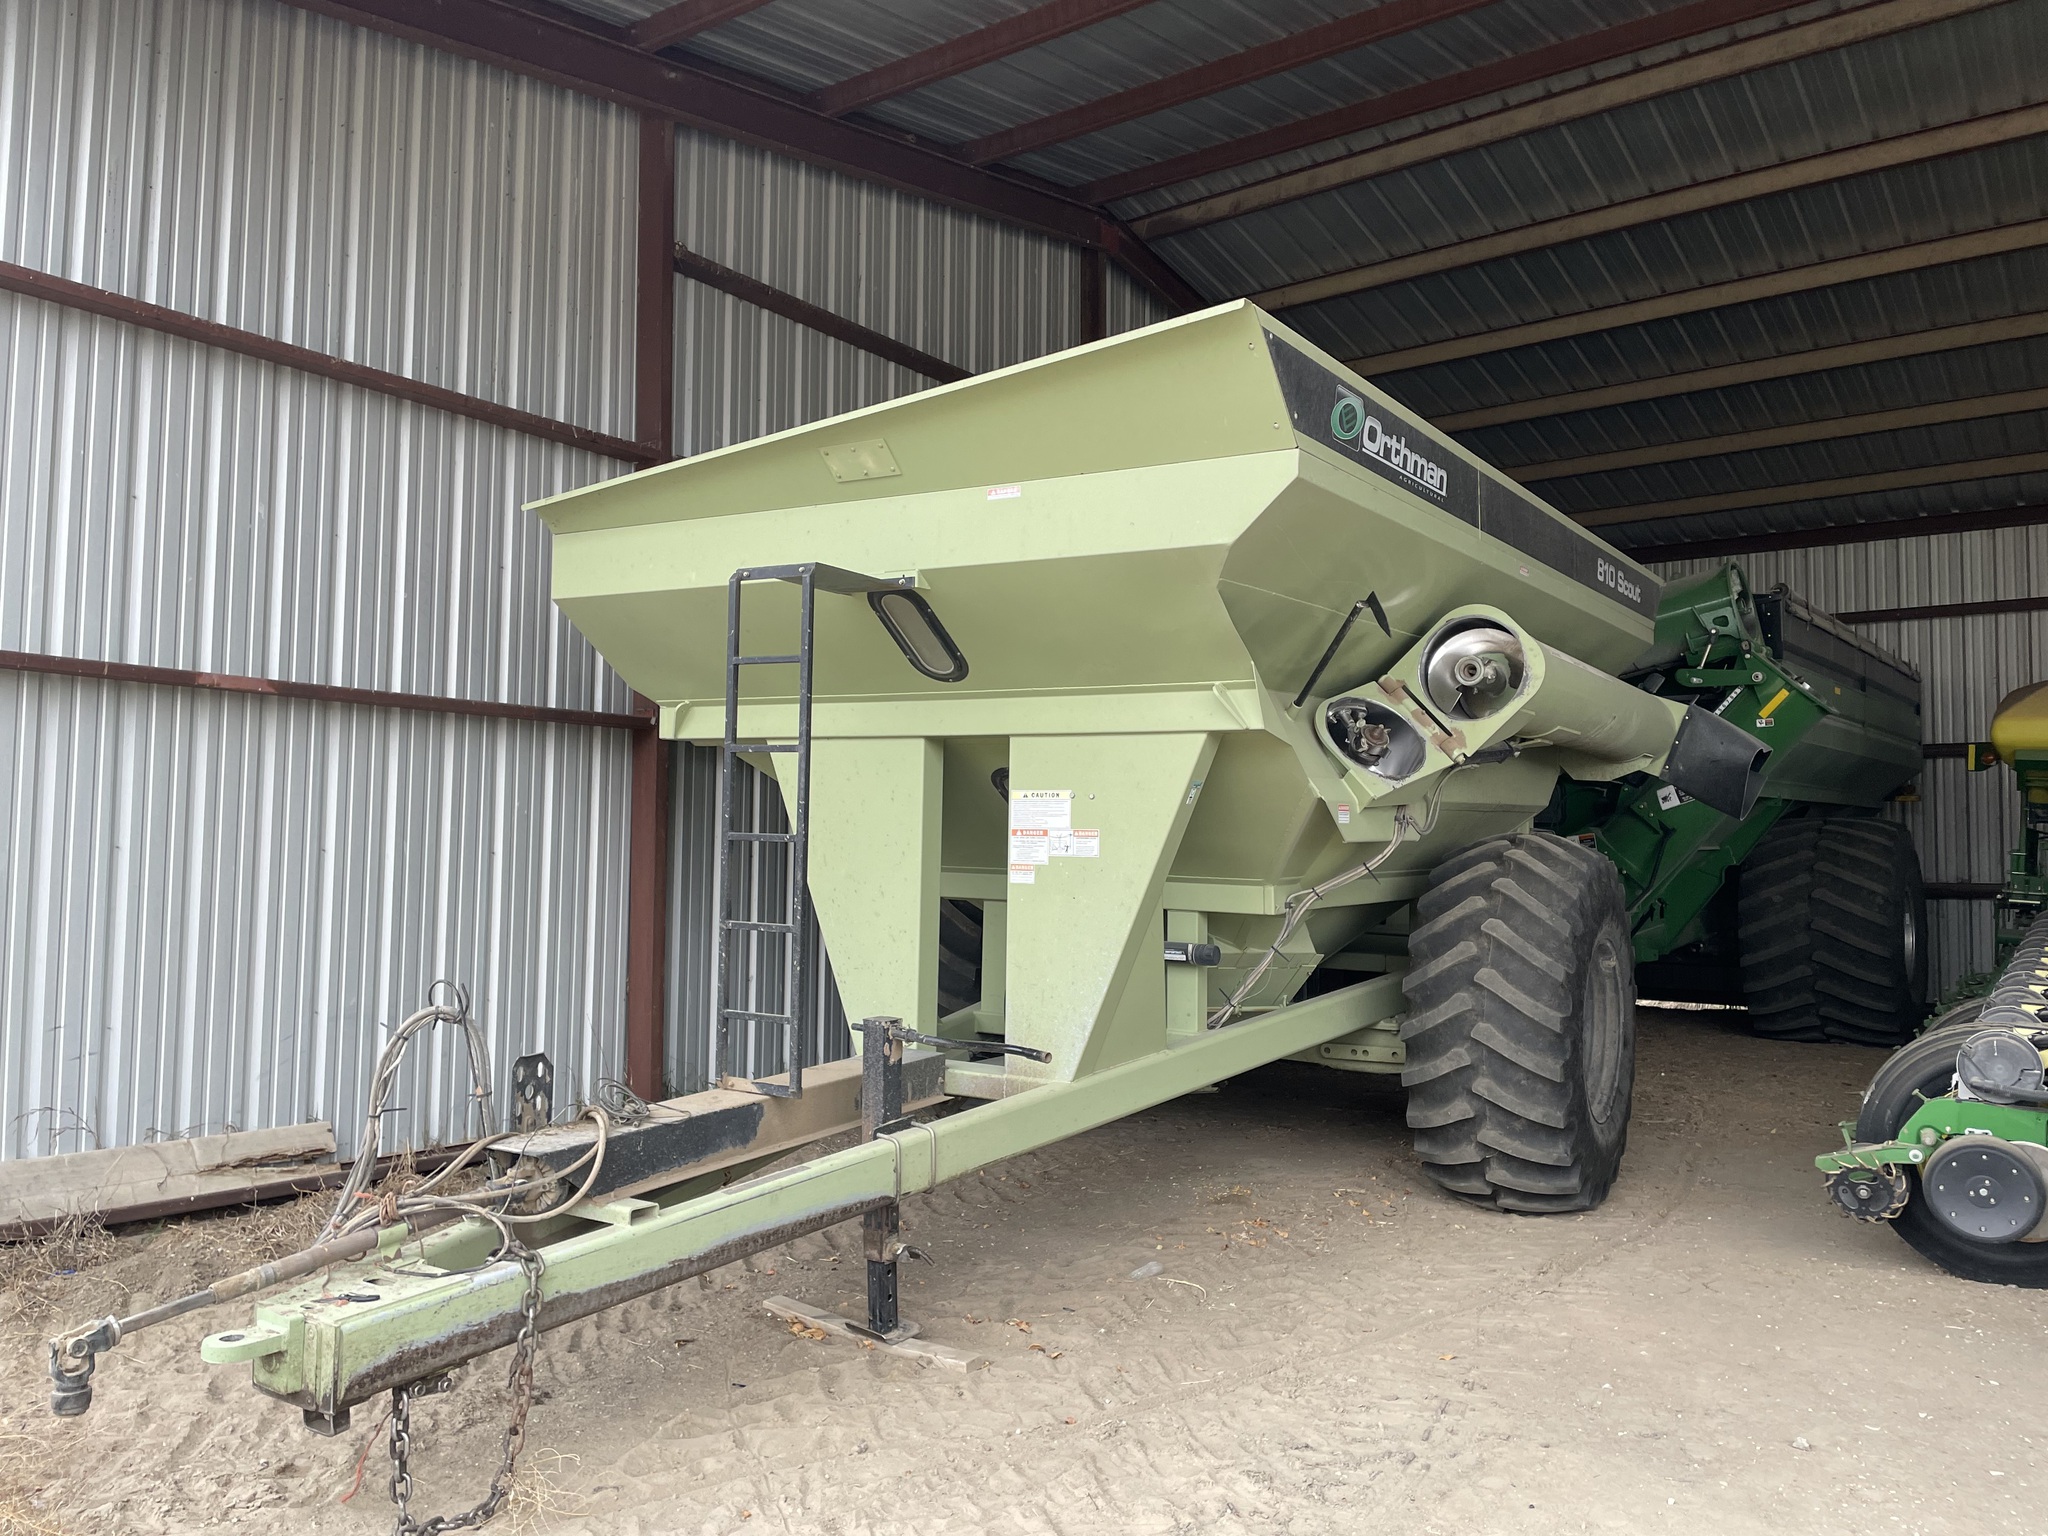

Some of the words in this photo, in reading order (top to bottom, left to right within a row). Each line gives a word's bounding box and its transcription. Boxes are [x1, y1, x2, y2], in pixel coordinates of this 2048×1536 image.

[1362, 415, 1447, 495] Orthman
[1399, 475, 1445, 502] AGRICULTURAL
[1597, 557, 1616, 588] 810
[1617, 570, 1641, 603] Scout
